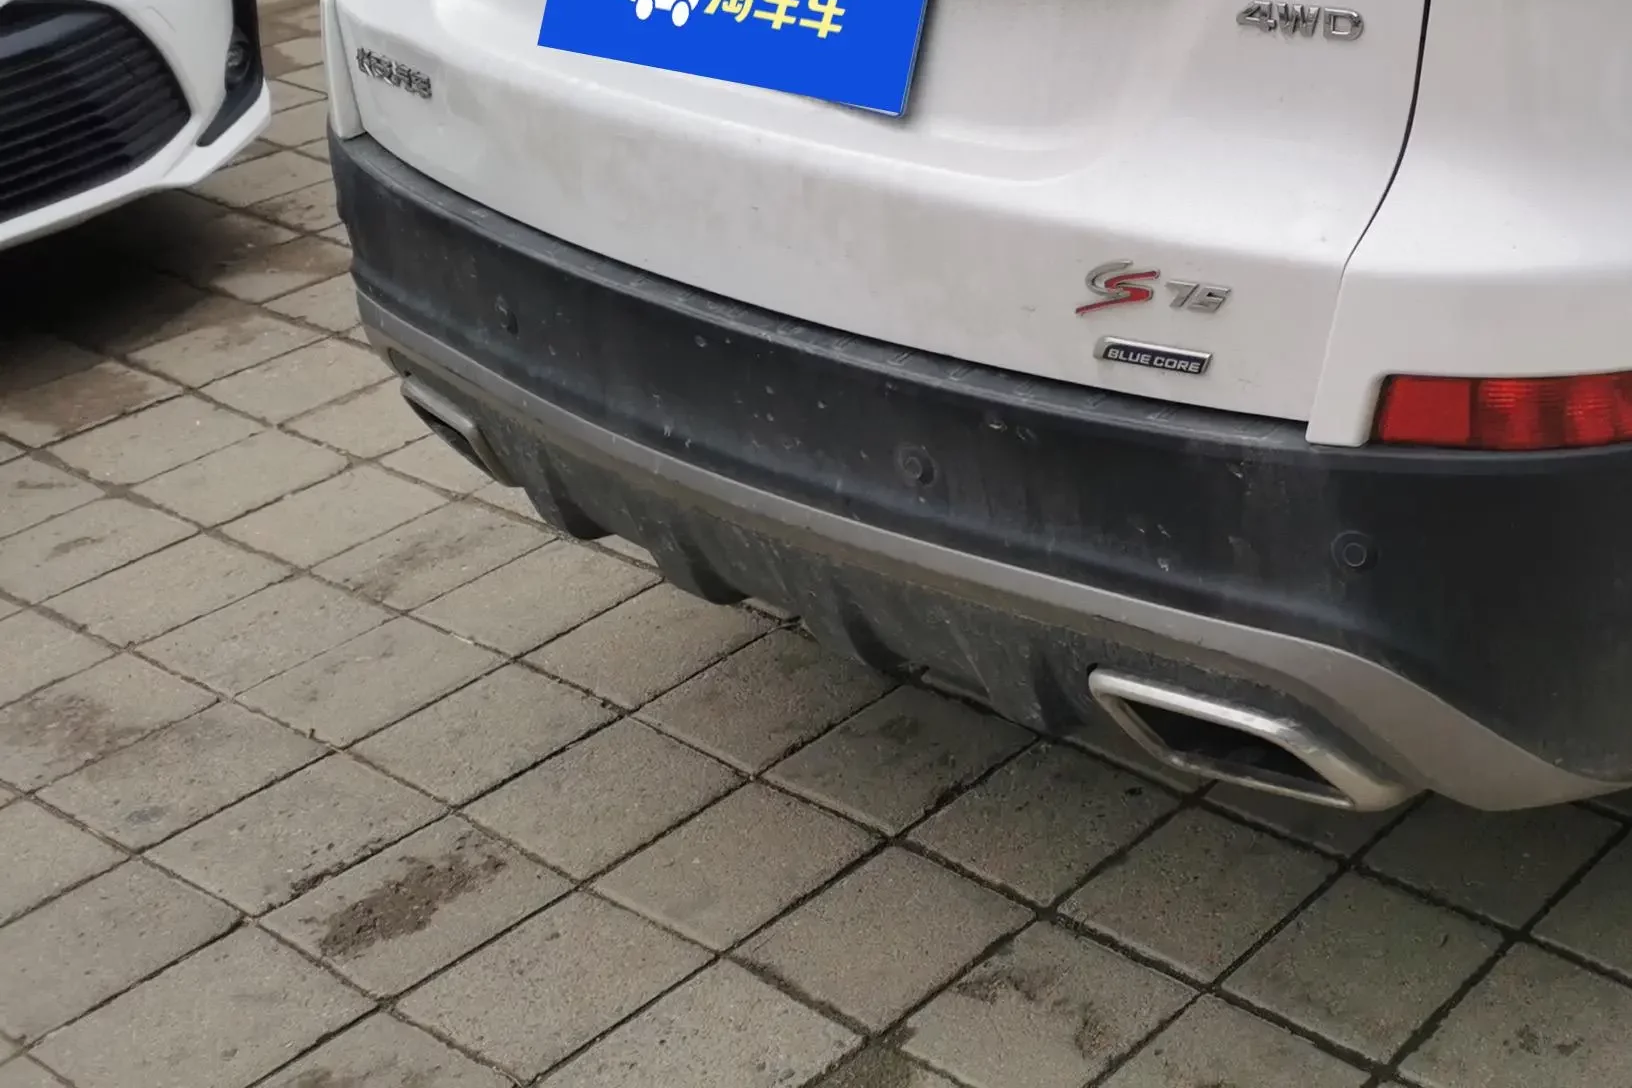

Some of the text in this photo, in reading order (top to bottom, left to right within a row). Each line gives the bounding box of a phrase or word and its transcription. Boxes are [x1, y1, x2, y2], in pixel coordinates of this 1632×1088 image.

[1236, 0, 1364, 41] 4WD
[1107, 347, 1201, 372] BLUE CORE
